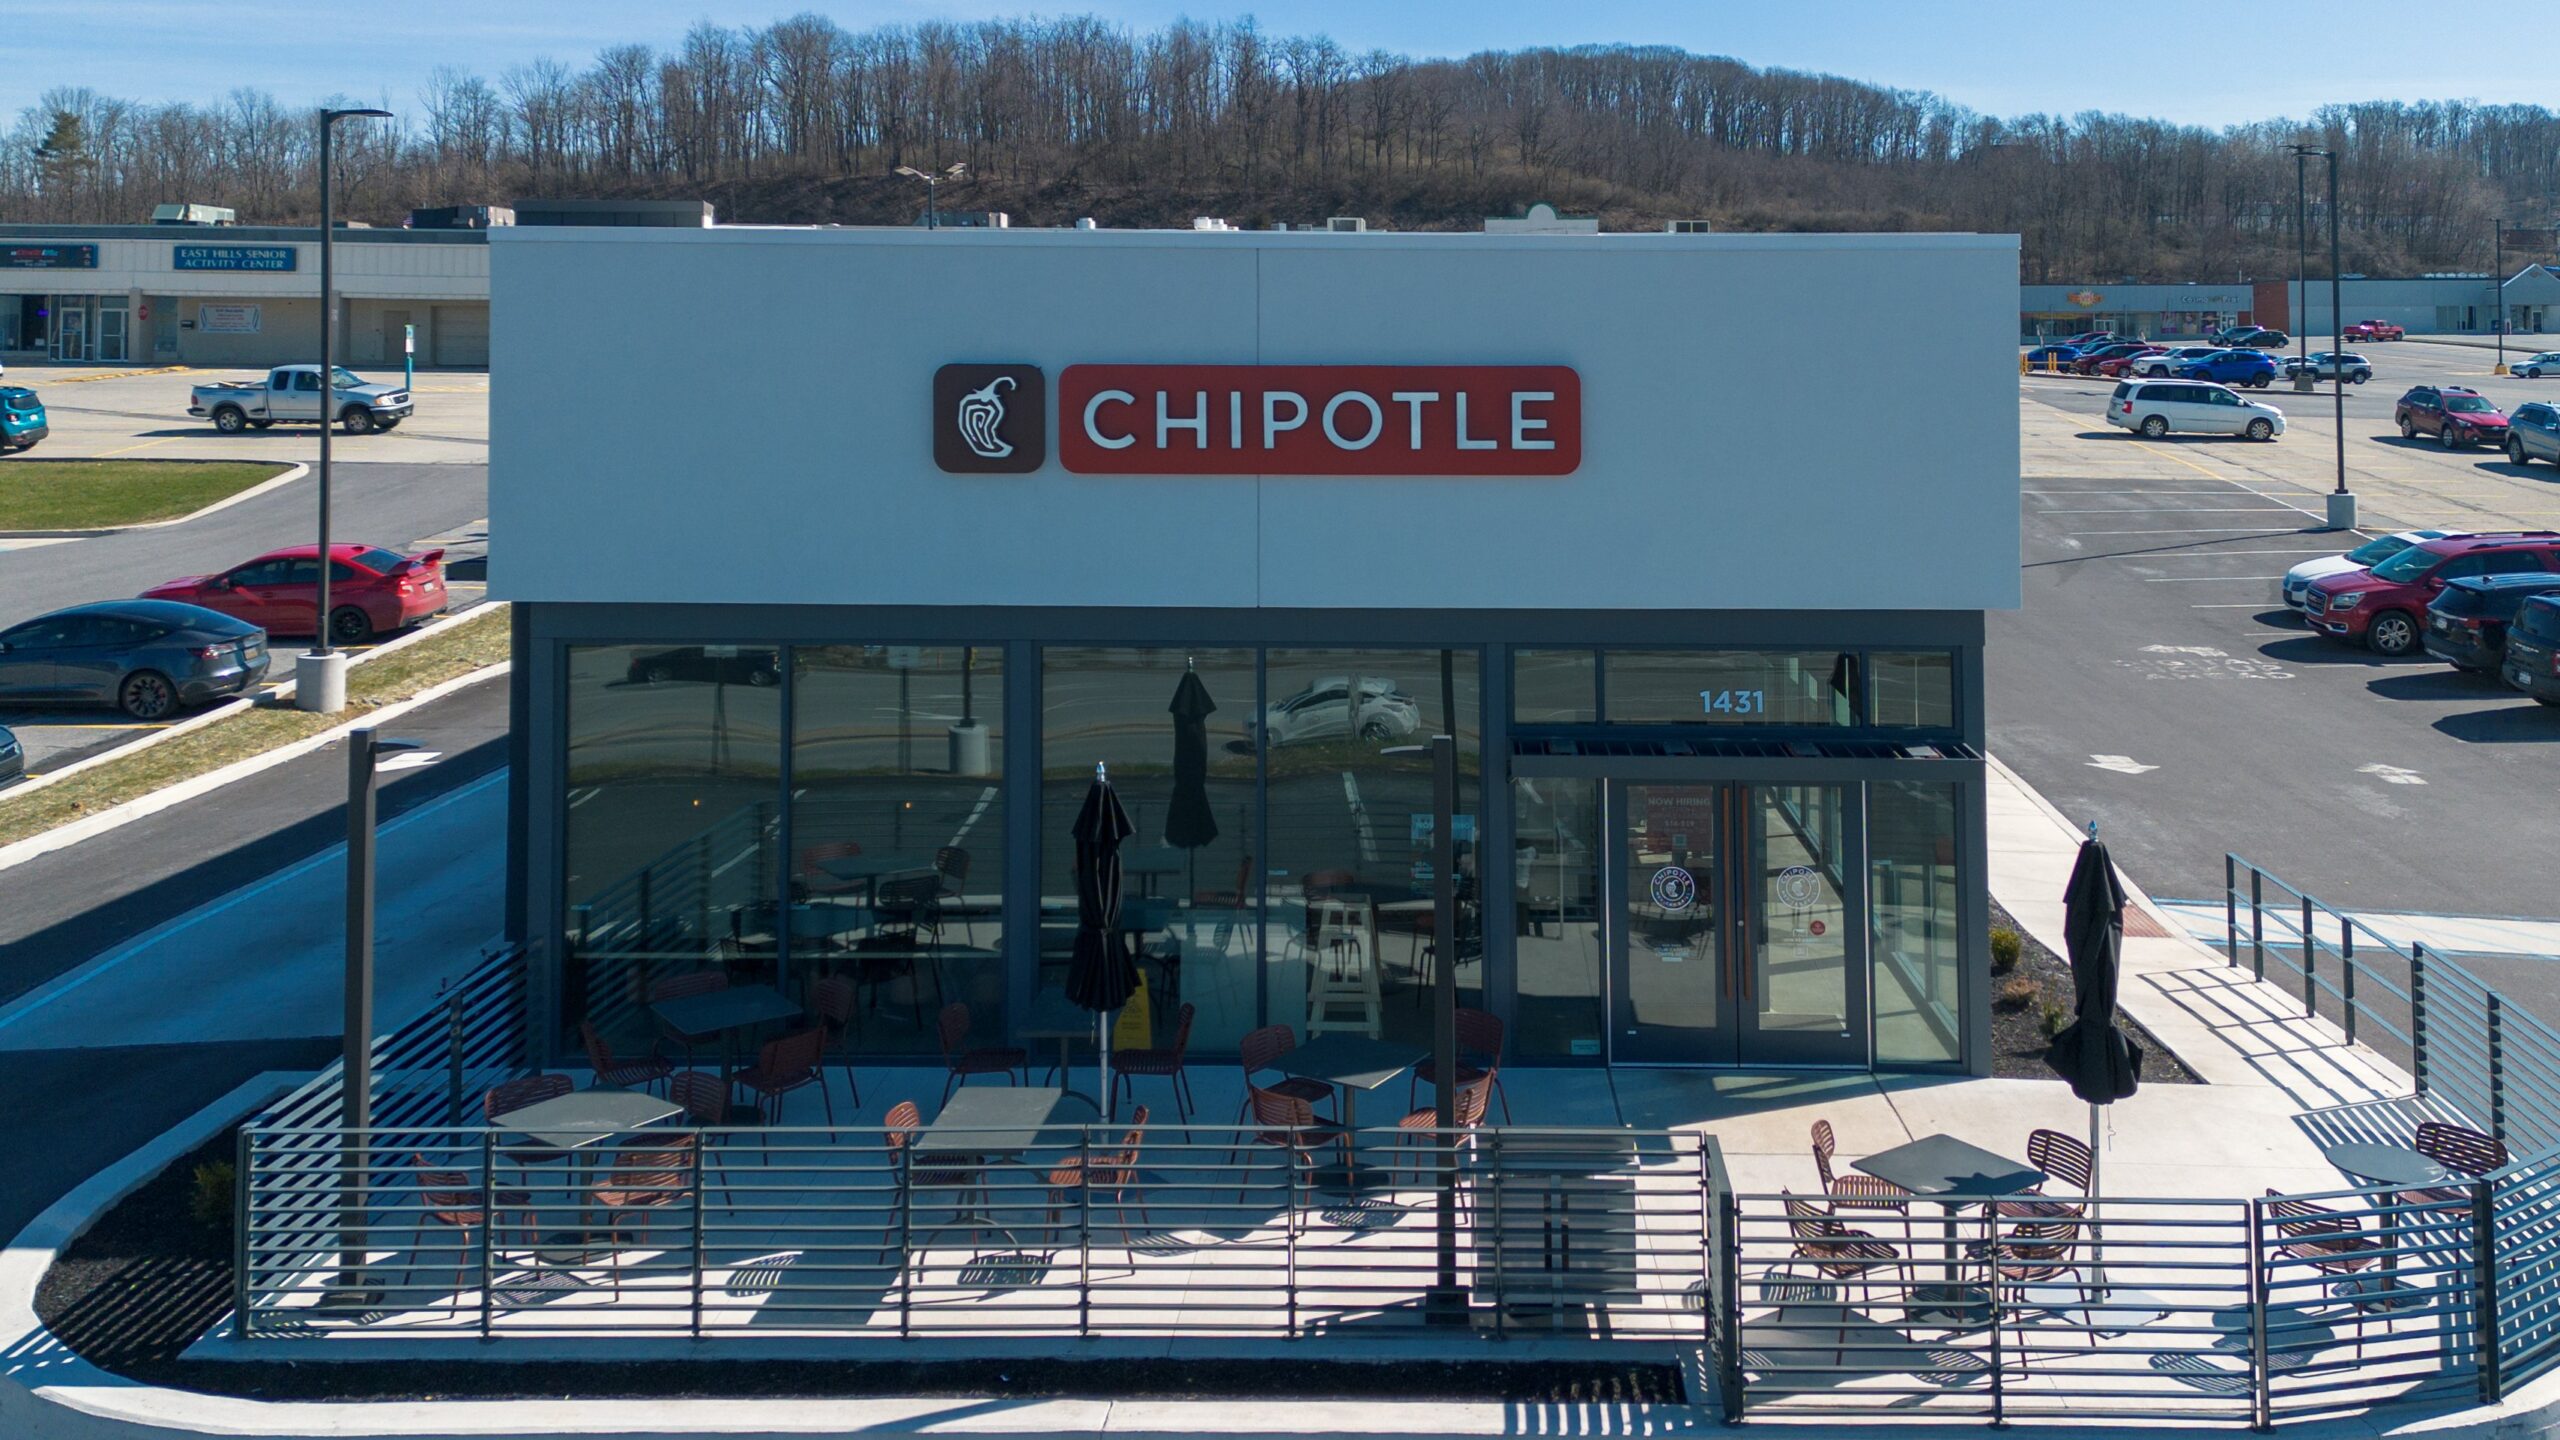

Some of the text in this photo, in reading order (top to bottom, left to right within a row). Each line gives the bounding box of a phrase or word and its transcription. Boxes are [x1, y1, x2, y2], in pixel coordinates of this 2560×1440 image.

[181, 249, 287, 259] EAST HILLS SENIOR
[184, 259, 285, 268] ACTIVITY CENTER
[1083, 389, 1556, 451] CHIPOTLE
[1699, 690, 1764, 713] 1431
[1647, 797, 1711, 807] NOW HIRING
[1654, 869, 1692, 887] CHIPOTLE
